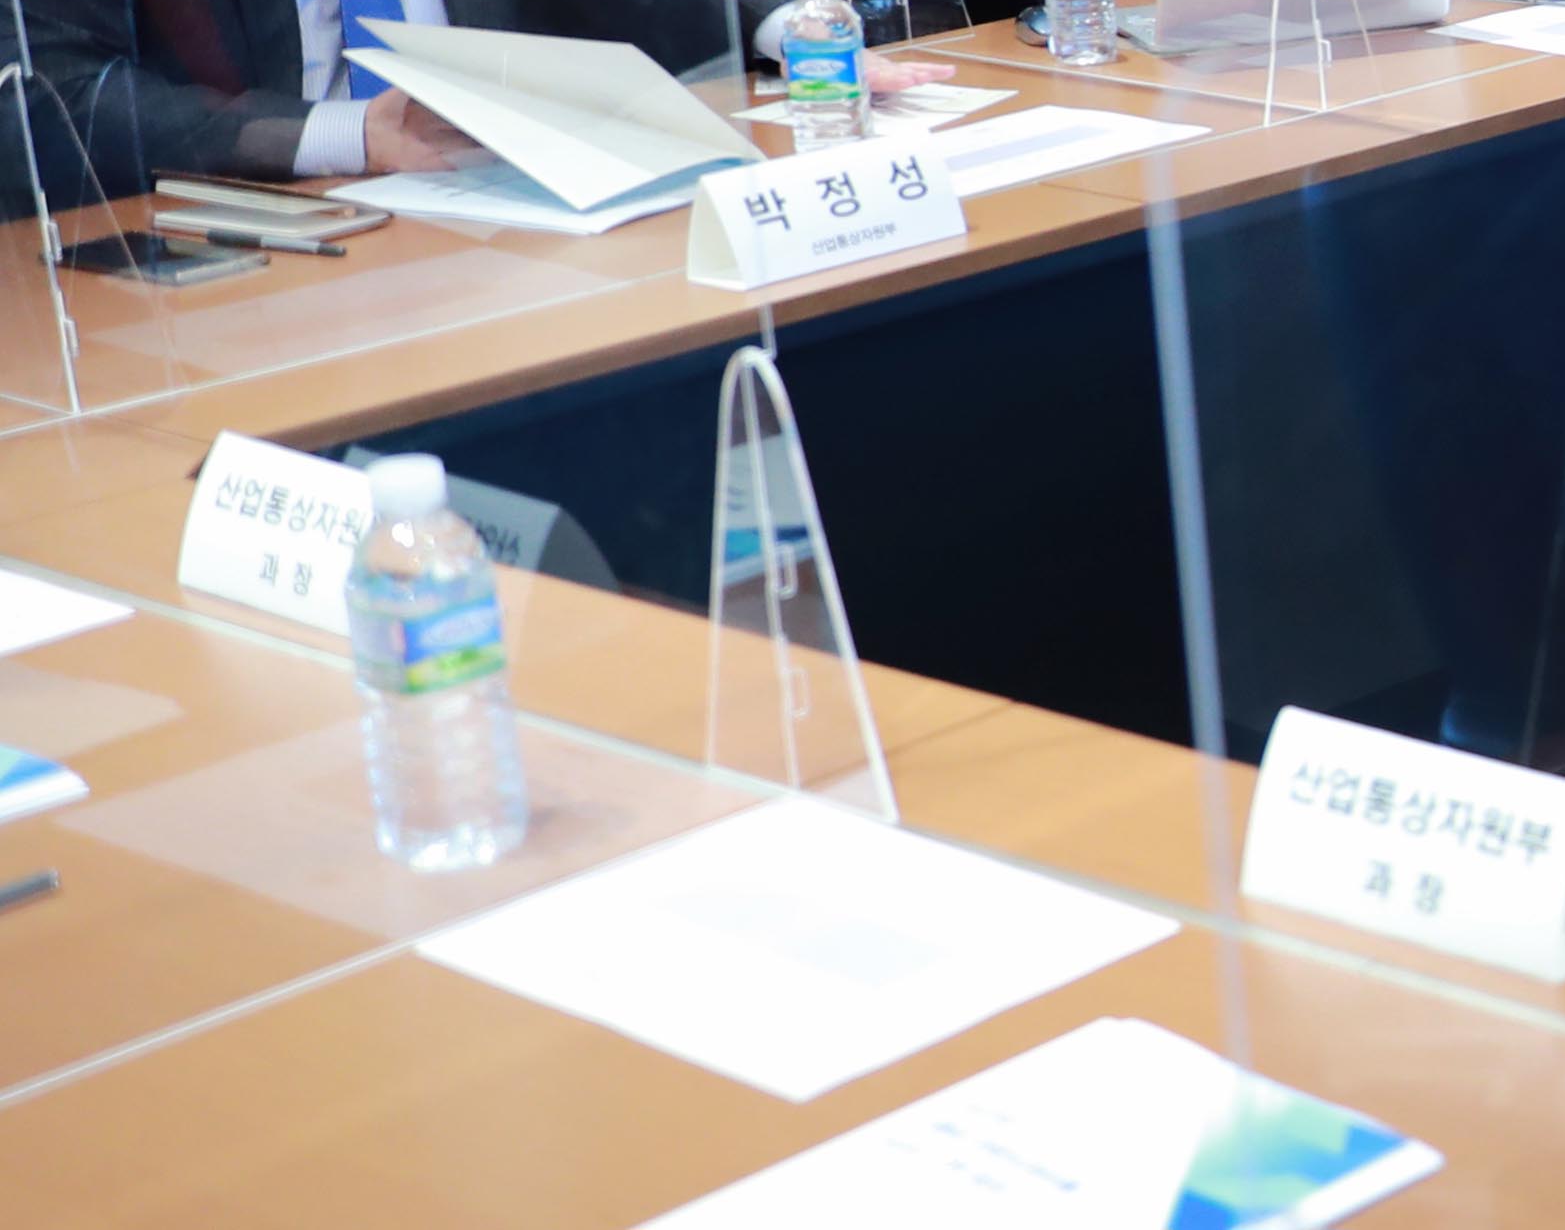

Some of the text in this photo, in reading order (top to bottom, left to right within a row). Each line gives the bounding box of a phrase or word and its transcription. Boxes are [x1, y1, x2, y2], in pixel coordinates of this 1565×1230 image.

[743, 155, 928, 231] 박정성
[811, 222, 897, 256] 산업통상자원부
[1289, 762, 1552, 864] 산업통상자원부
